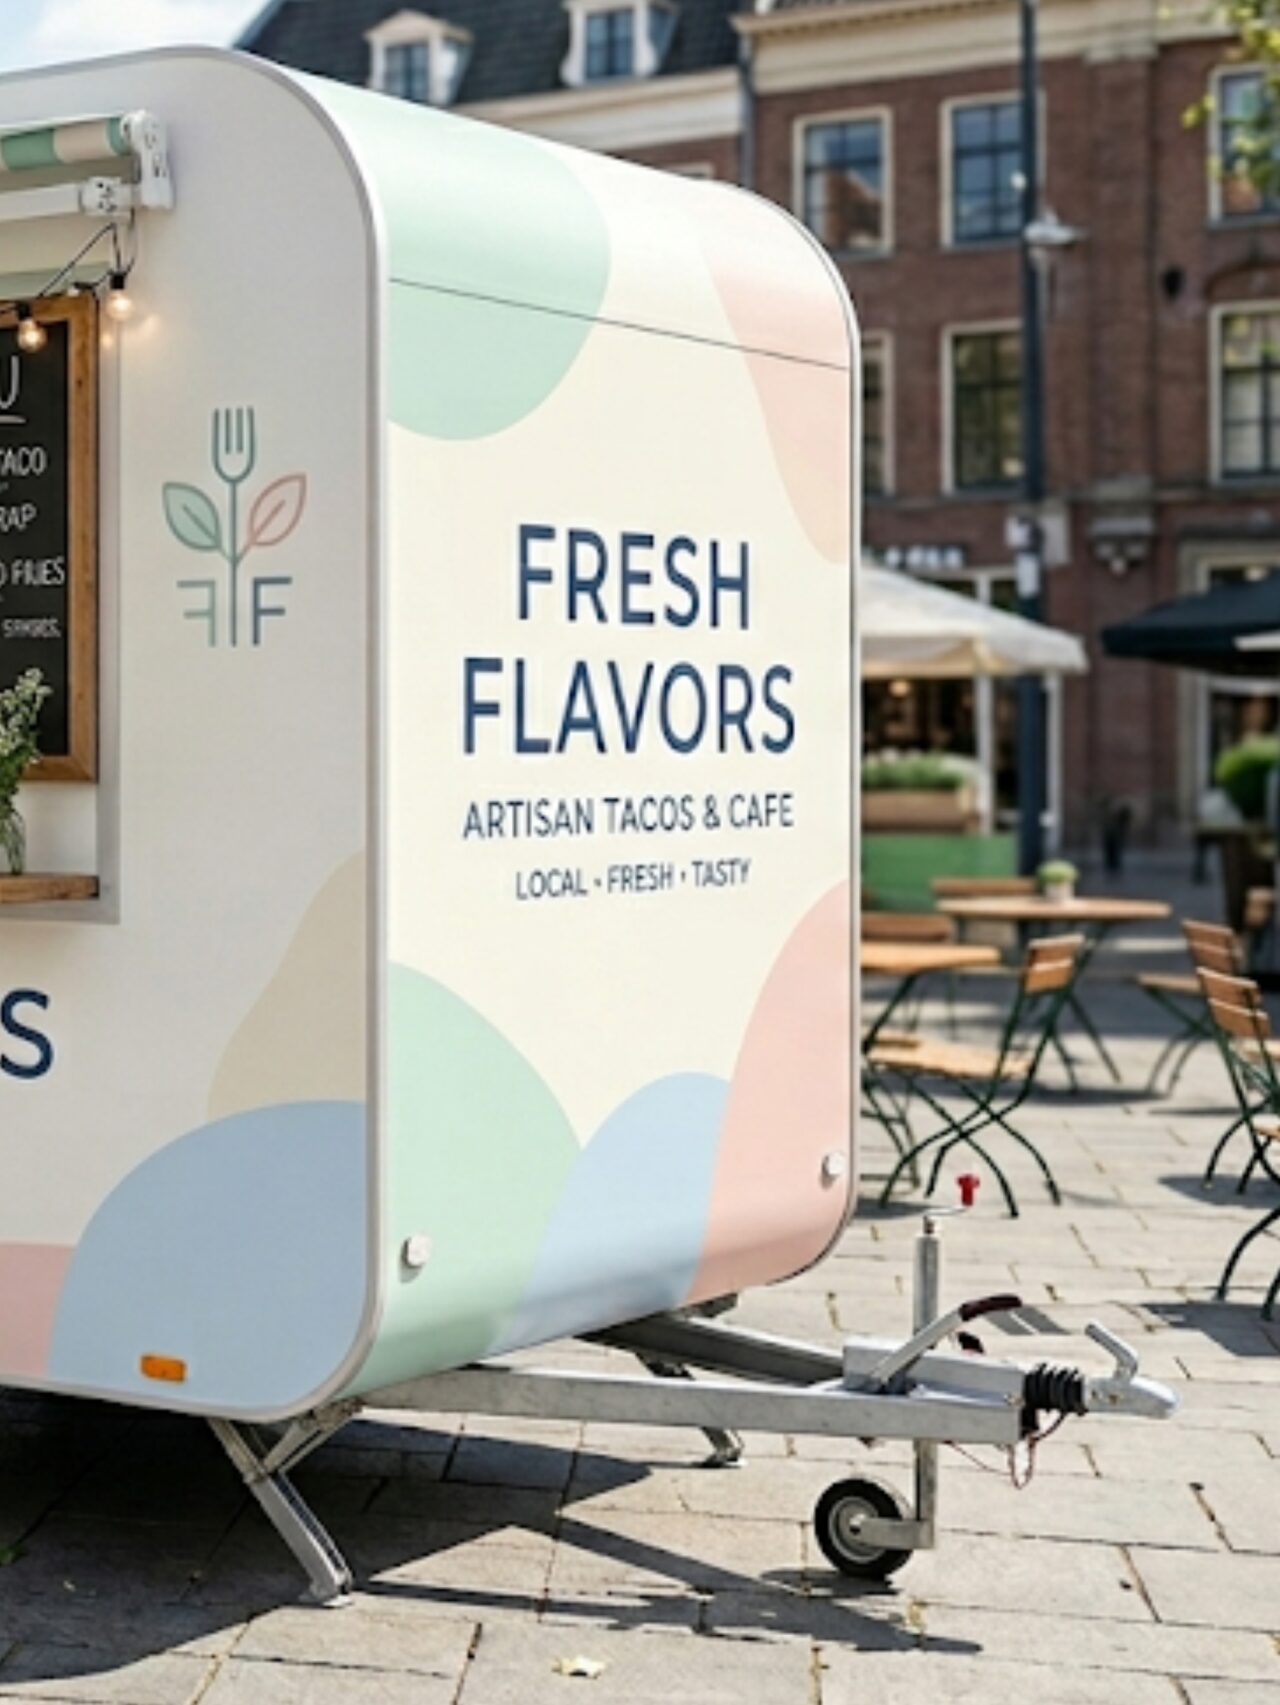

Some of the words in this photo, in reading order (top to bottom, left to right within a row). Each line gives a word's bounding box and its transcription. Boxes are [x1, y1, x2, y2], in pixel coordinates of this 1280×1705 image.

[518, 523, 749, 630] FRESH
[464, 656, 795, 754] FLAVORS
[463, 798, 593, 839] ARTISAN
[602, 794, 695, 832] TACOS
[702, 795, 721, 830] &
[728, 792, 794, 828] CAFE
[516, 868, 588, 900] LOCAL
[607, 863, 674, 893] FRESH
[691, 857, 751, 887] TASTY
